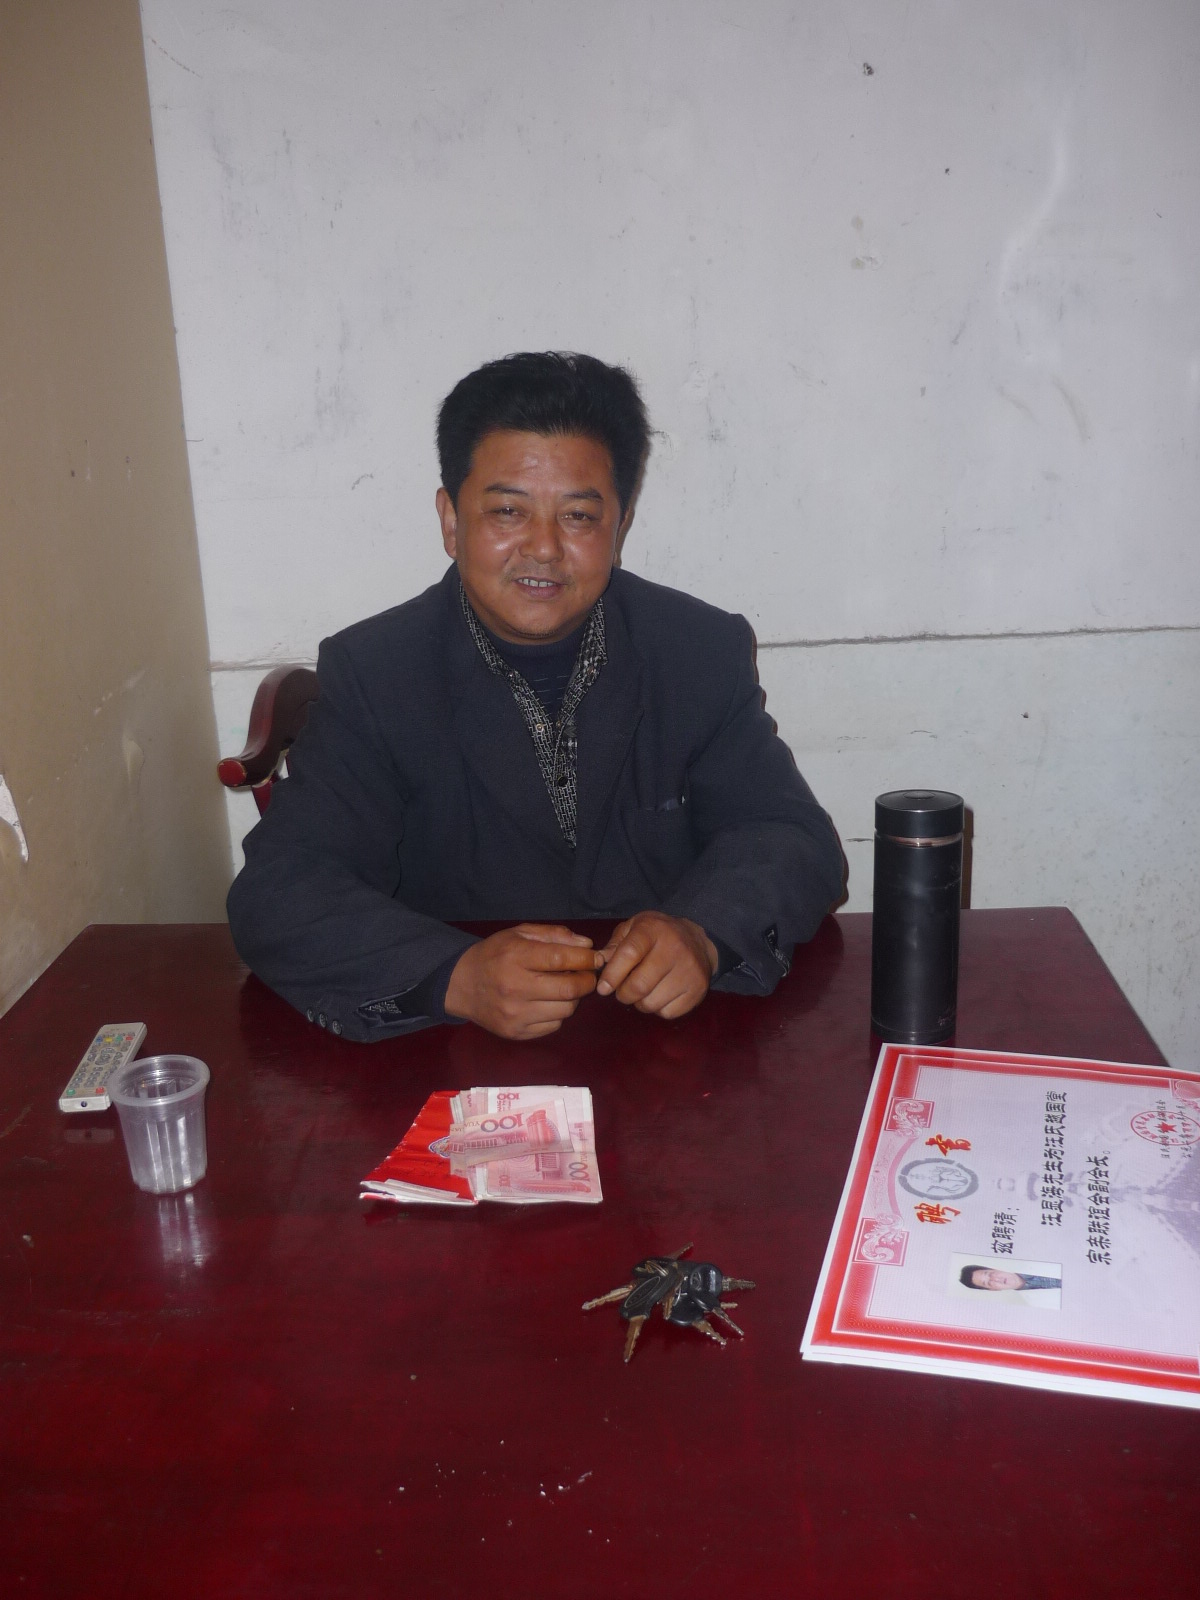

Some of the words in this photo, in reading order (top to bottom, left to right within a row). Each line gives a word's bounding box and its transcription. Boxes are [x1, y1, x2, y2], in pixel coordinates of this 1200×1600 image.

[497, 1092, 520, 1100] 100
[480, 1113, 525, 1133] 100
[1041, 1090, 1067, 1226] 汪显海先生为汪氏越国堂
[569, 1161, 591, 1182] 100
